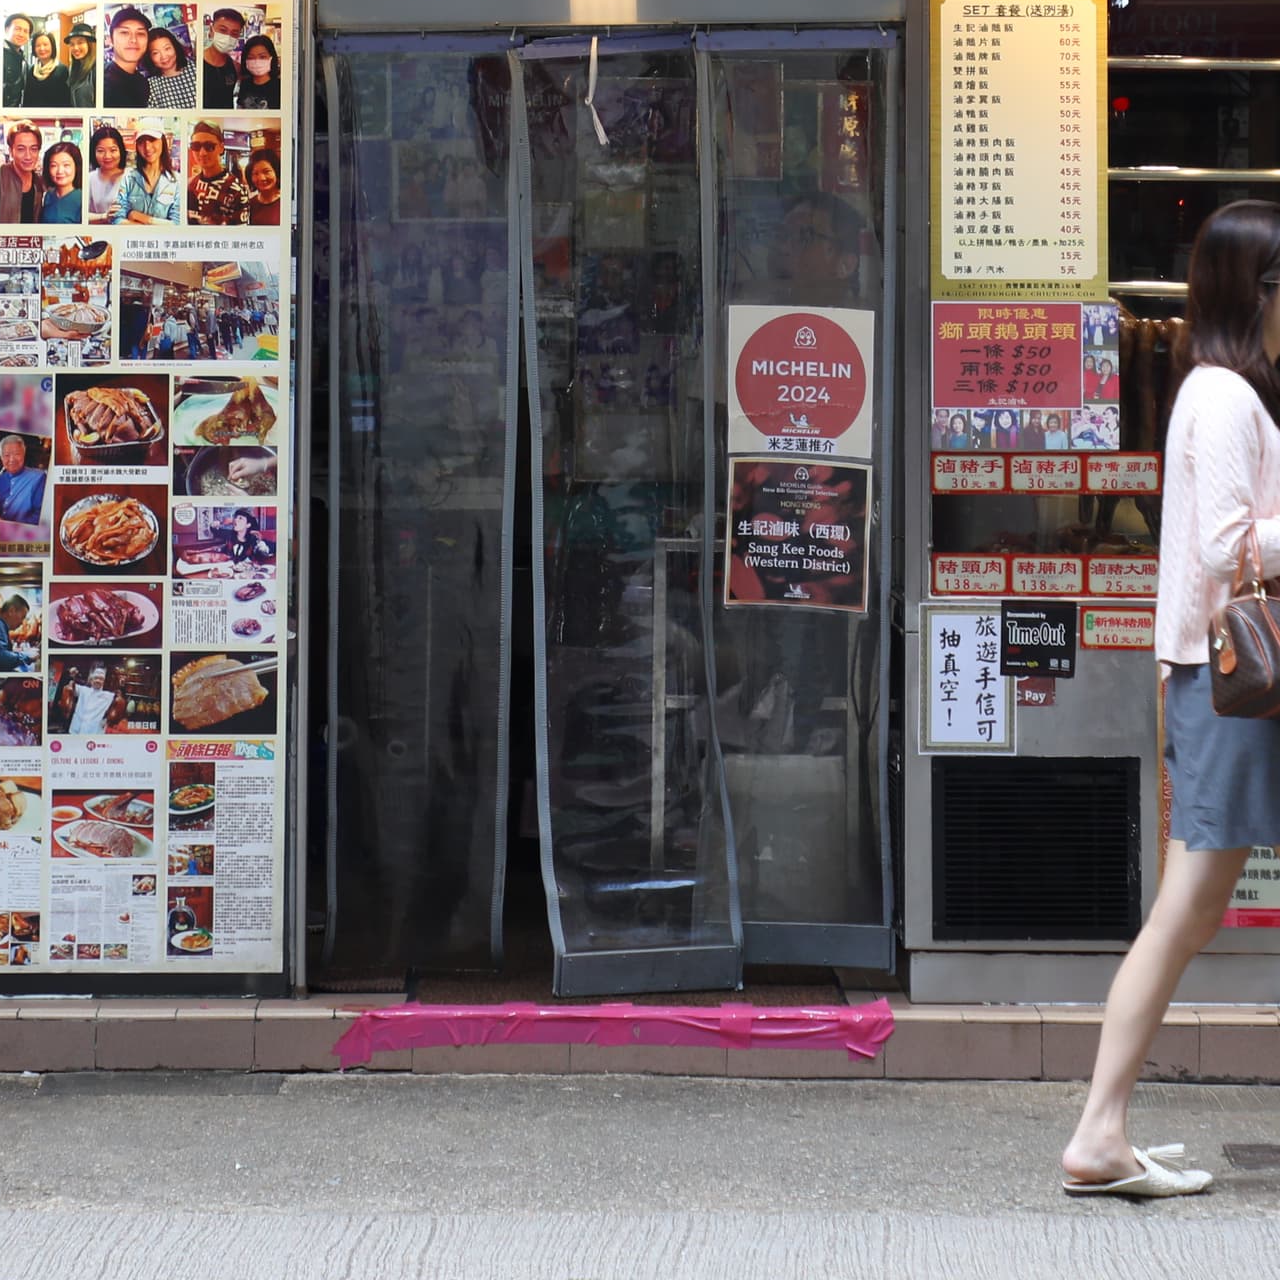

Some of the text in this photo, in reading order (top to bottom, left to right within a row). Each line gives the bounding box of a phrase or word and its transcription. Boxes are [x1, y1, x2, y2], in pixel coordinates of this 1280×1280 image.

[963, 5, 990, 15] SET
[995, 4, 1020, 16] 套餐
[1060, 24, 1081, 32] 55元
[1060, 38, 1081, 47] 60元
[1060, 53, 1081, 61] 70元
[1060, 66, 1081, 75] 55元
[1060, 81, 1081, 89] 55元
[1060, 96, 1081, 104] 55元
[1060, 110, 1081, 118] 50元
[1060, 124, 1081, 133] 50元
[1060, 139, 1081, 147] 45元
[1060, 153, 1081, 162] 45元
[1060, 168, 1081, 176] 45元
[1060, 182, 1081, 191] 45元
[1060, 196, 1081, 205] 45元
[1060, 211, 1081, 220] 45元
[1060, 225, 1081, 234] 40元
[1061, 252, 1081, 260] 15元
[977, 308, 1048, 320] 限時優惠
[938, 322, 1077, 340] 獅頭鵝頭頸
[960, 344, 1052, 359] 一條 $50
[751, 360, 852, 379] MICHELIN
[1012, 361, 1052, 377] $80
[953, 379, 1058, 394] 三條 $100
[777, 385, 831, 404] 2024
[768, 438, 835, 453] 米芝蓮推介
[936, 459, 1002, 474] 滷豬手
[1013, 459, 1078, 474] 滷豬利
[748, 542, 844, 559] Sang Kee Foods
[744, 555, 851, 574] (Western District)
[22, 679, 39, 689] CNN
[975, 615, 998, 742] 旅遊手信可
[1024, 690, 1047, 703] Pay
[176, 743, 232, 758] 頭條日報
[234, 742, 260, 758] 飲食
